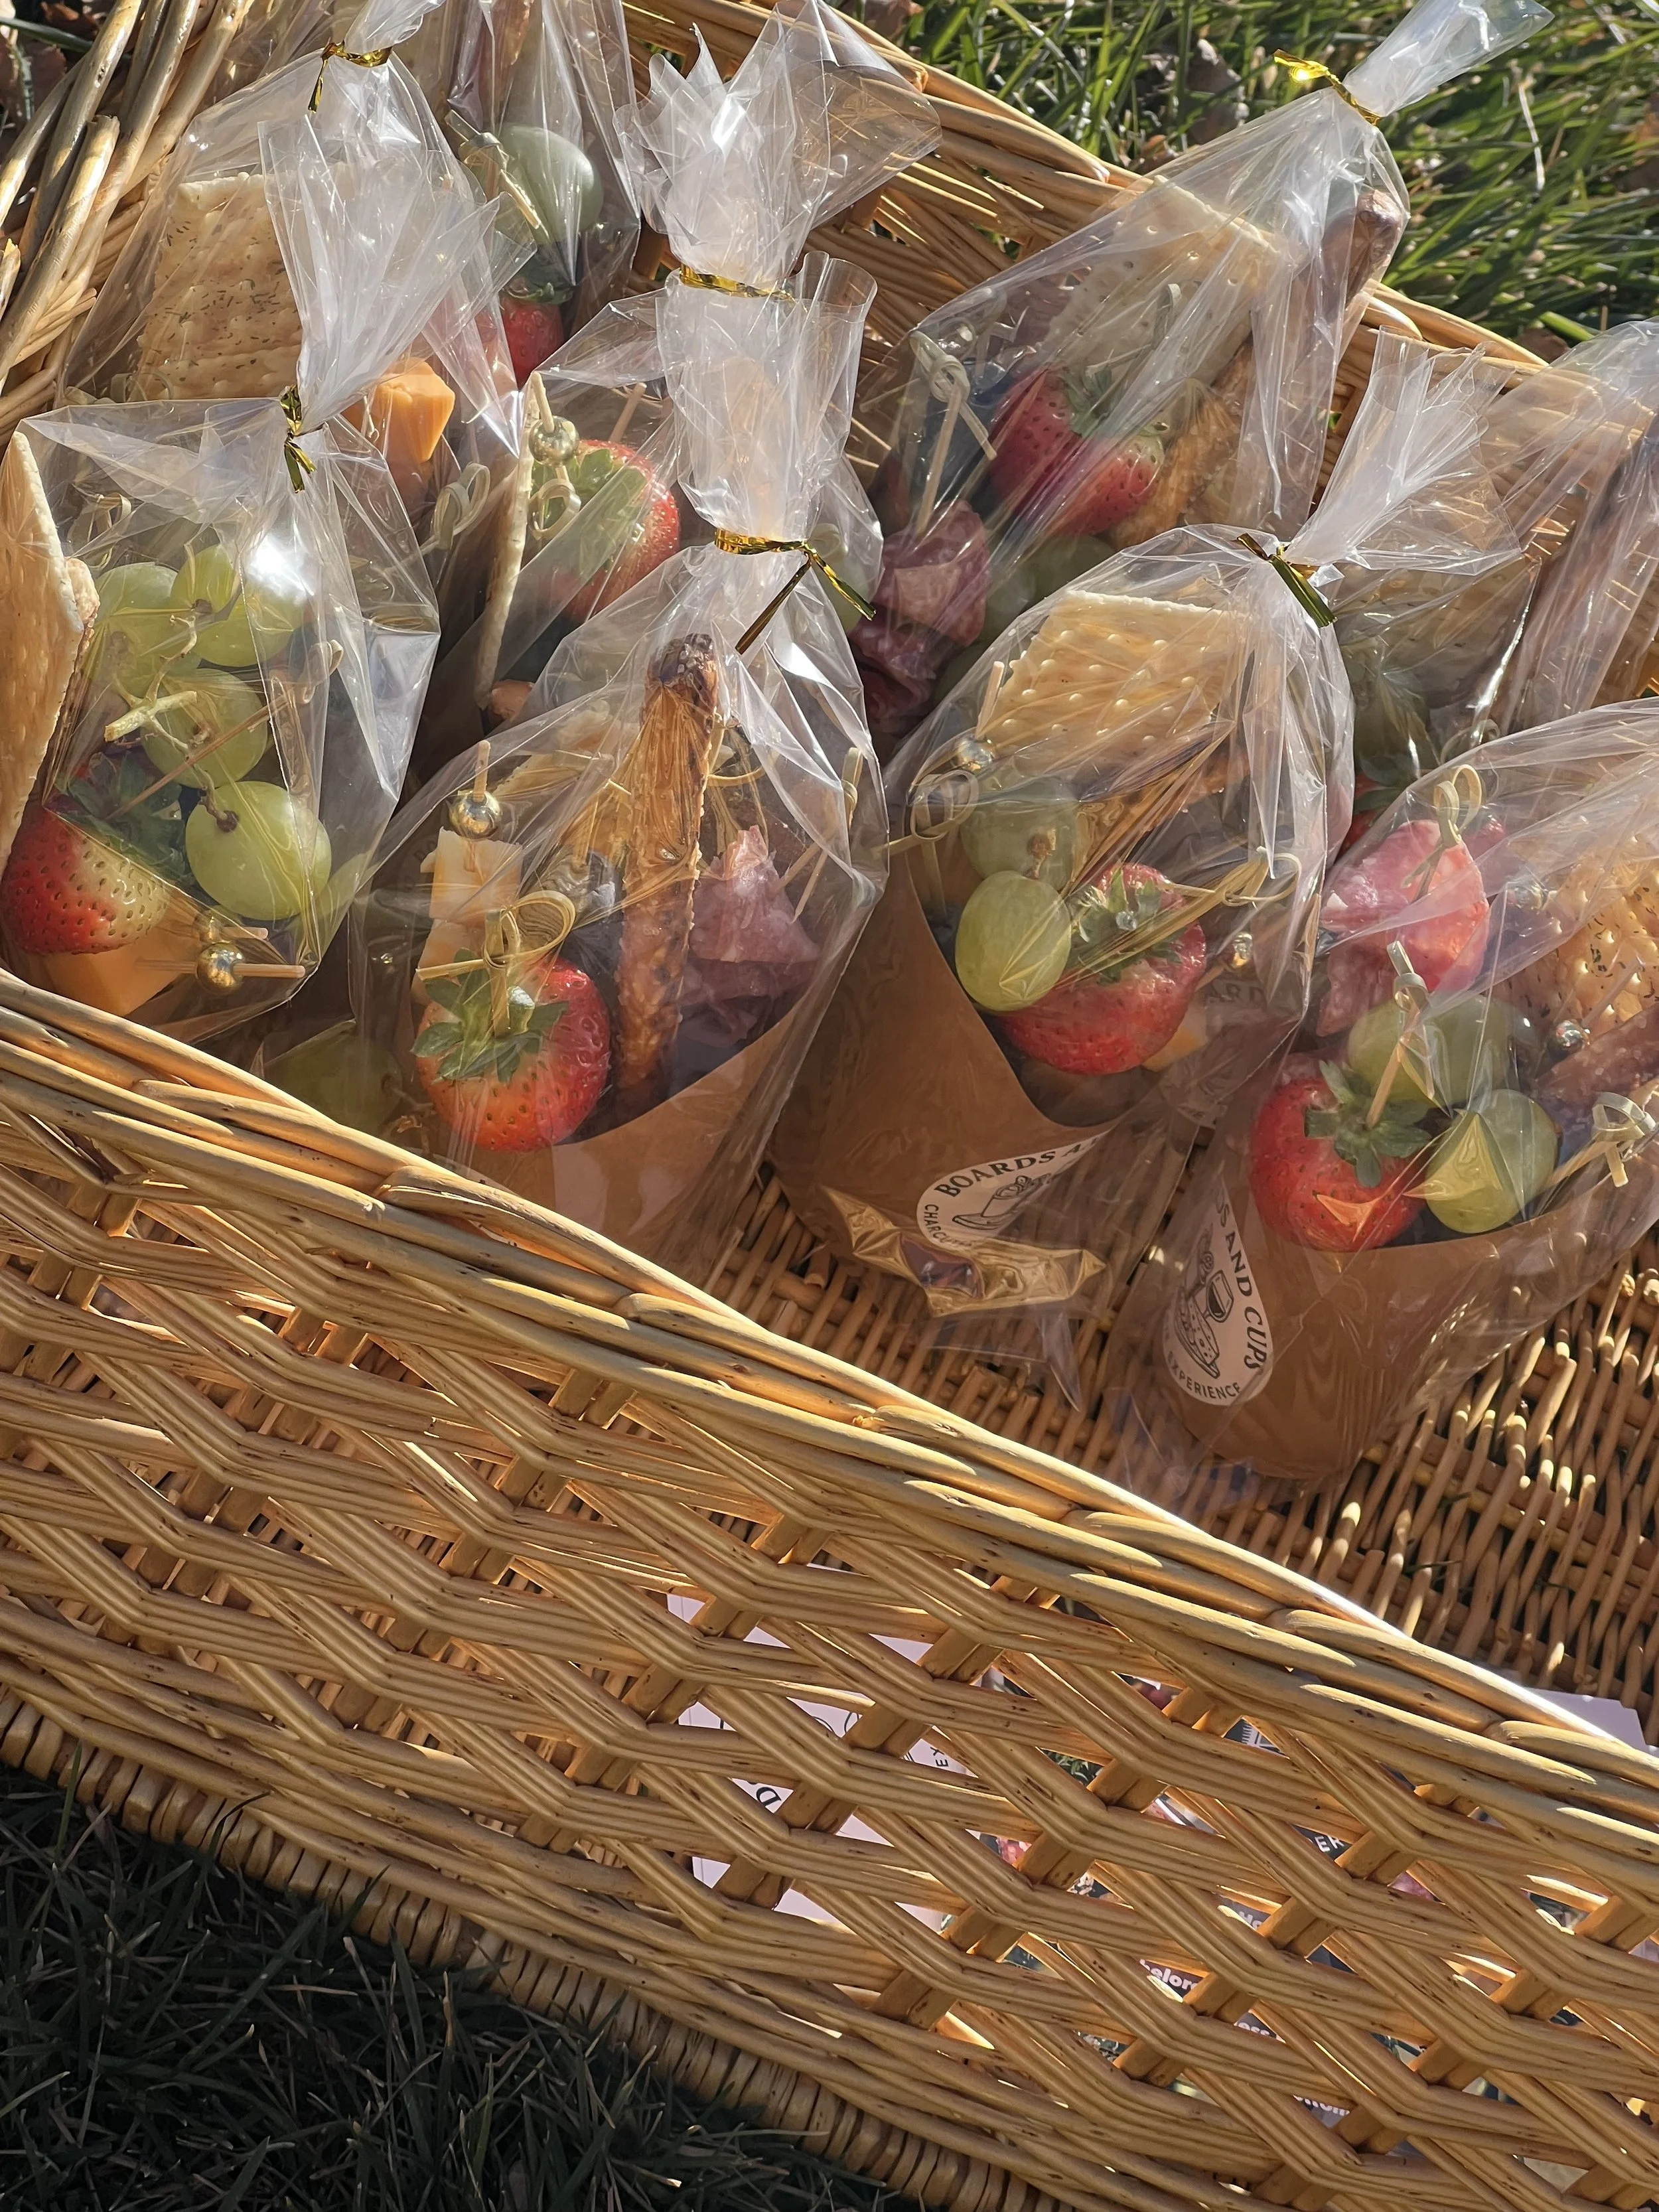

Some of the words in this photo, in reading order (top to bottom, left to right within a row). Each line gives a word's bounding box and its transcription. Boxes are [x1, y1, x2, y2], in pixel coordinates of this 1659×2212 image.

[934, 1151, 1057, 1197] BOARDS
[1226, 1231, 1253, 1297] AND
[1244, 1306, 1267, 1369] CUPS
[1167, 1350, 1241, 1399] EXPERIENCE
